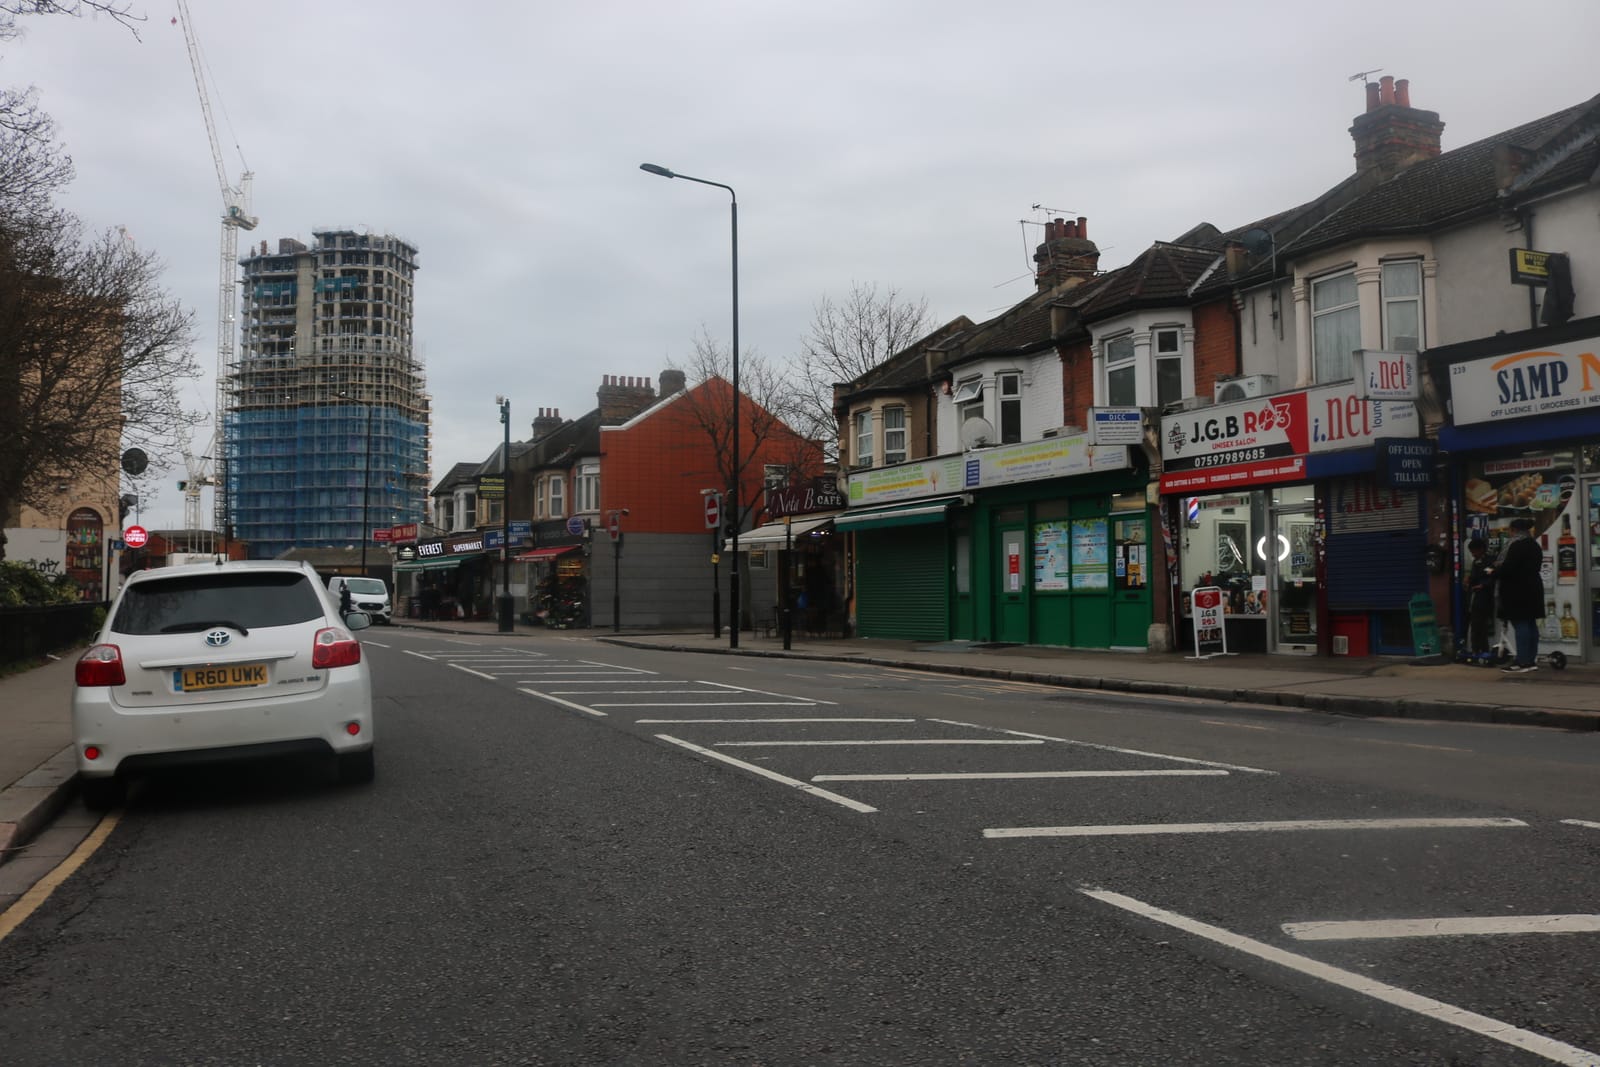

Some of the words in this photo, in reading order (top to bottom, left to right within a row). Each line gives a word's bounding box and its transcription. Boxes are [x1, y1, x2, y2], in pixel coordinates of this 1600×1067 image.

[1496, 360, 1569, 405] SAMP
[1491, 409, 1503, 417] OFF
[1504, 405, 1532, 415] LICENCE
[1540, 398, 1580, 410] GROCERIES
[1190, 415, 1240, 443] J.G.B
[1211, 440, 1234, 450] UNISEX
[1235, 437, 1257, 447] SALON
[1388, 444, 1403, 455] OFF
[1194, 447, 1266, 468] 07597989685
[1401, 459, 1422, 469] OPEN
[1394, 472, 1411, 482] TILL
[418, 542, 443, 557] EVEREST
[452, 541, 483, 553] SUPERMARKET
[184, 670, 228, 687] LR60
[232, 666, 265, 683] UWK
